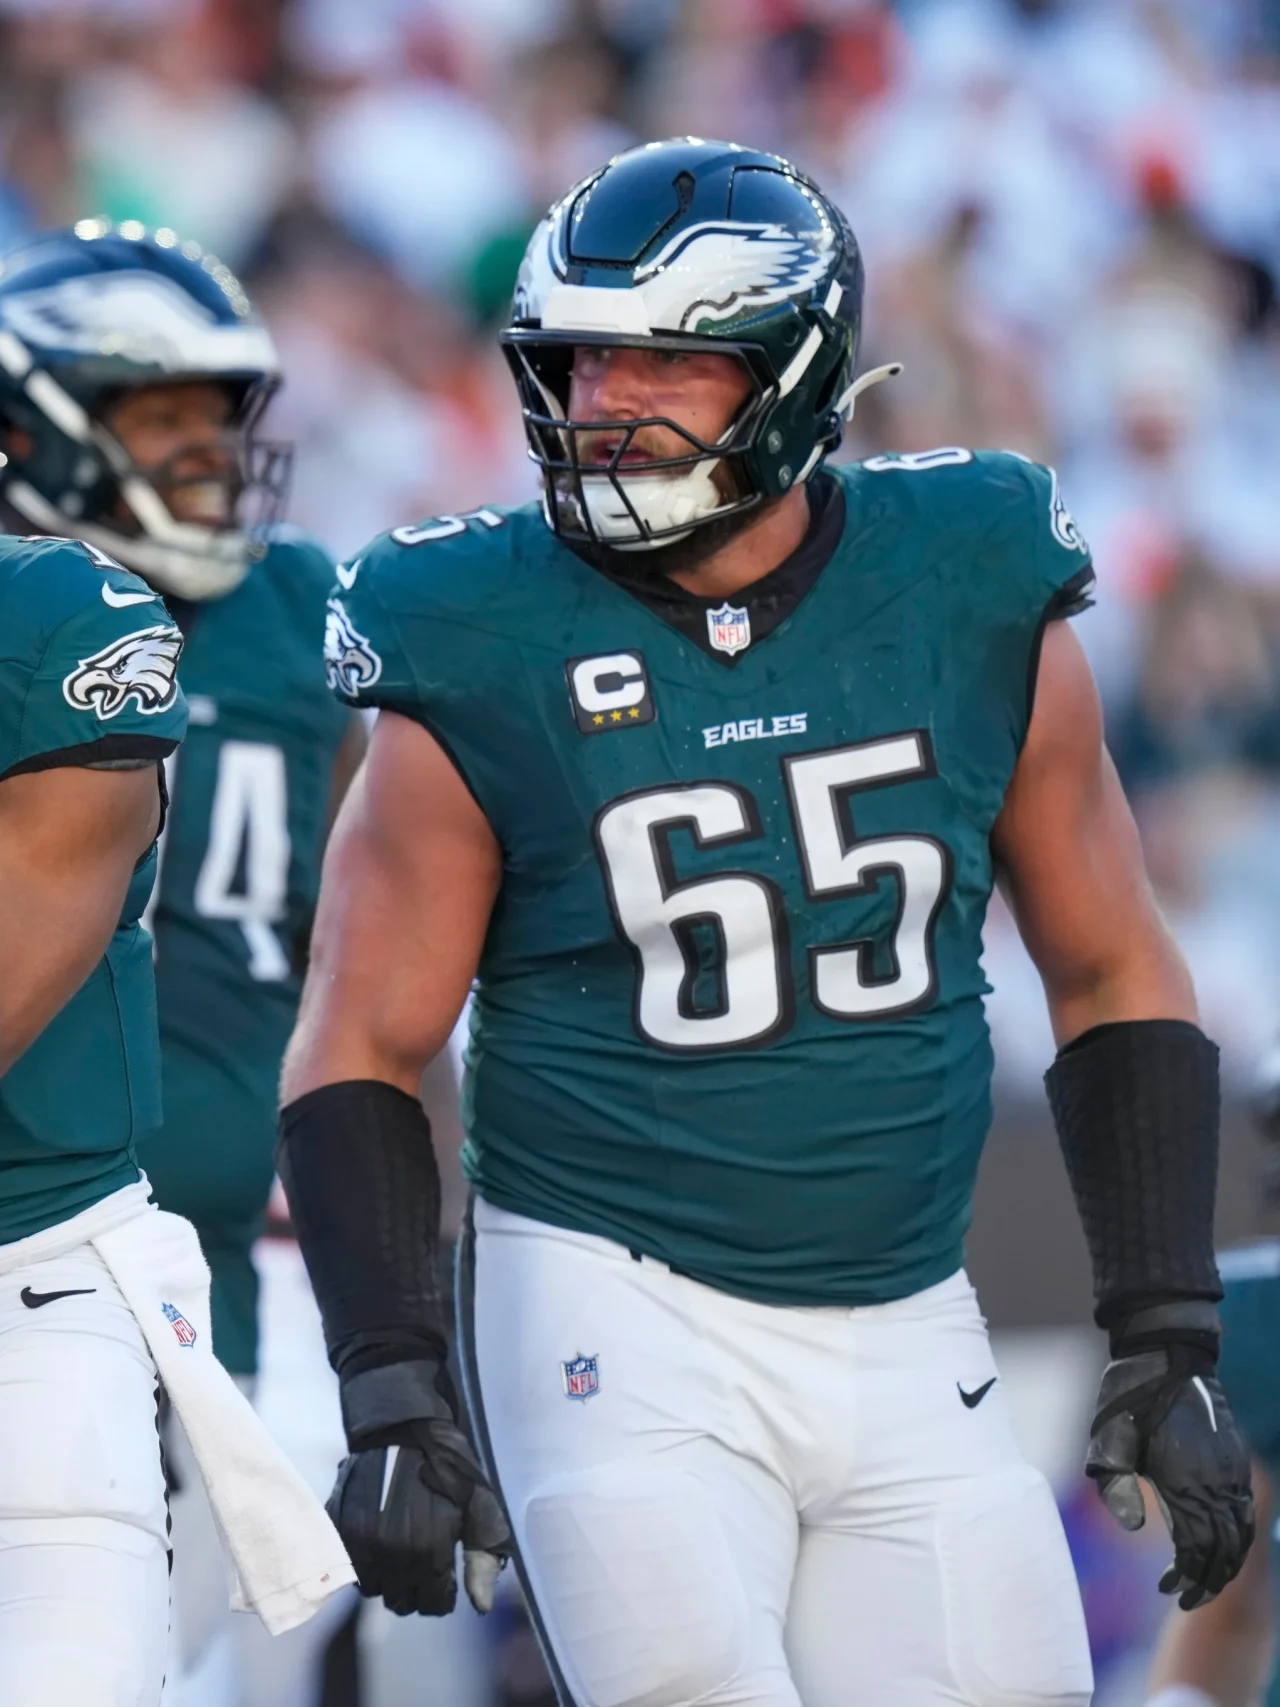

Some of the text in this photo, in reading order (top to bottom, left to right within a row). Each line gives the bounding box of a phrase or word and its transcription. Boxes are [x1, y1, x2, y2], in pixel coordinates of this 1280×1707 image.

[717, 625, 744, 645] NFL
[572, 653, 646, 713] C
[702, 712, 808, 749] EAGLES
[154, 738, 292, 982] 4
[591, 728, 956, 1057] 65
[569, 1372, 596, 1394] NFL
